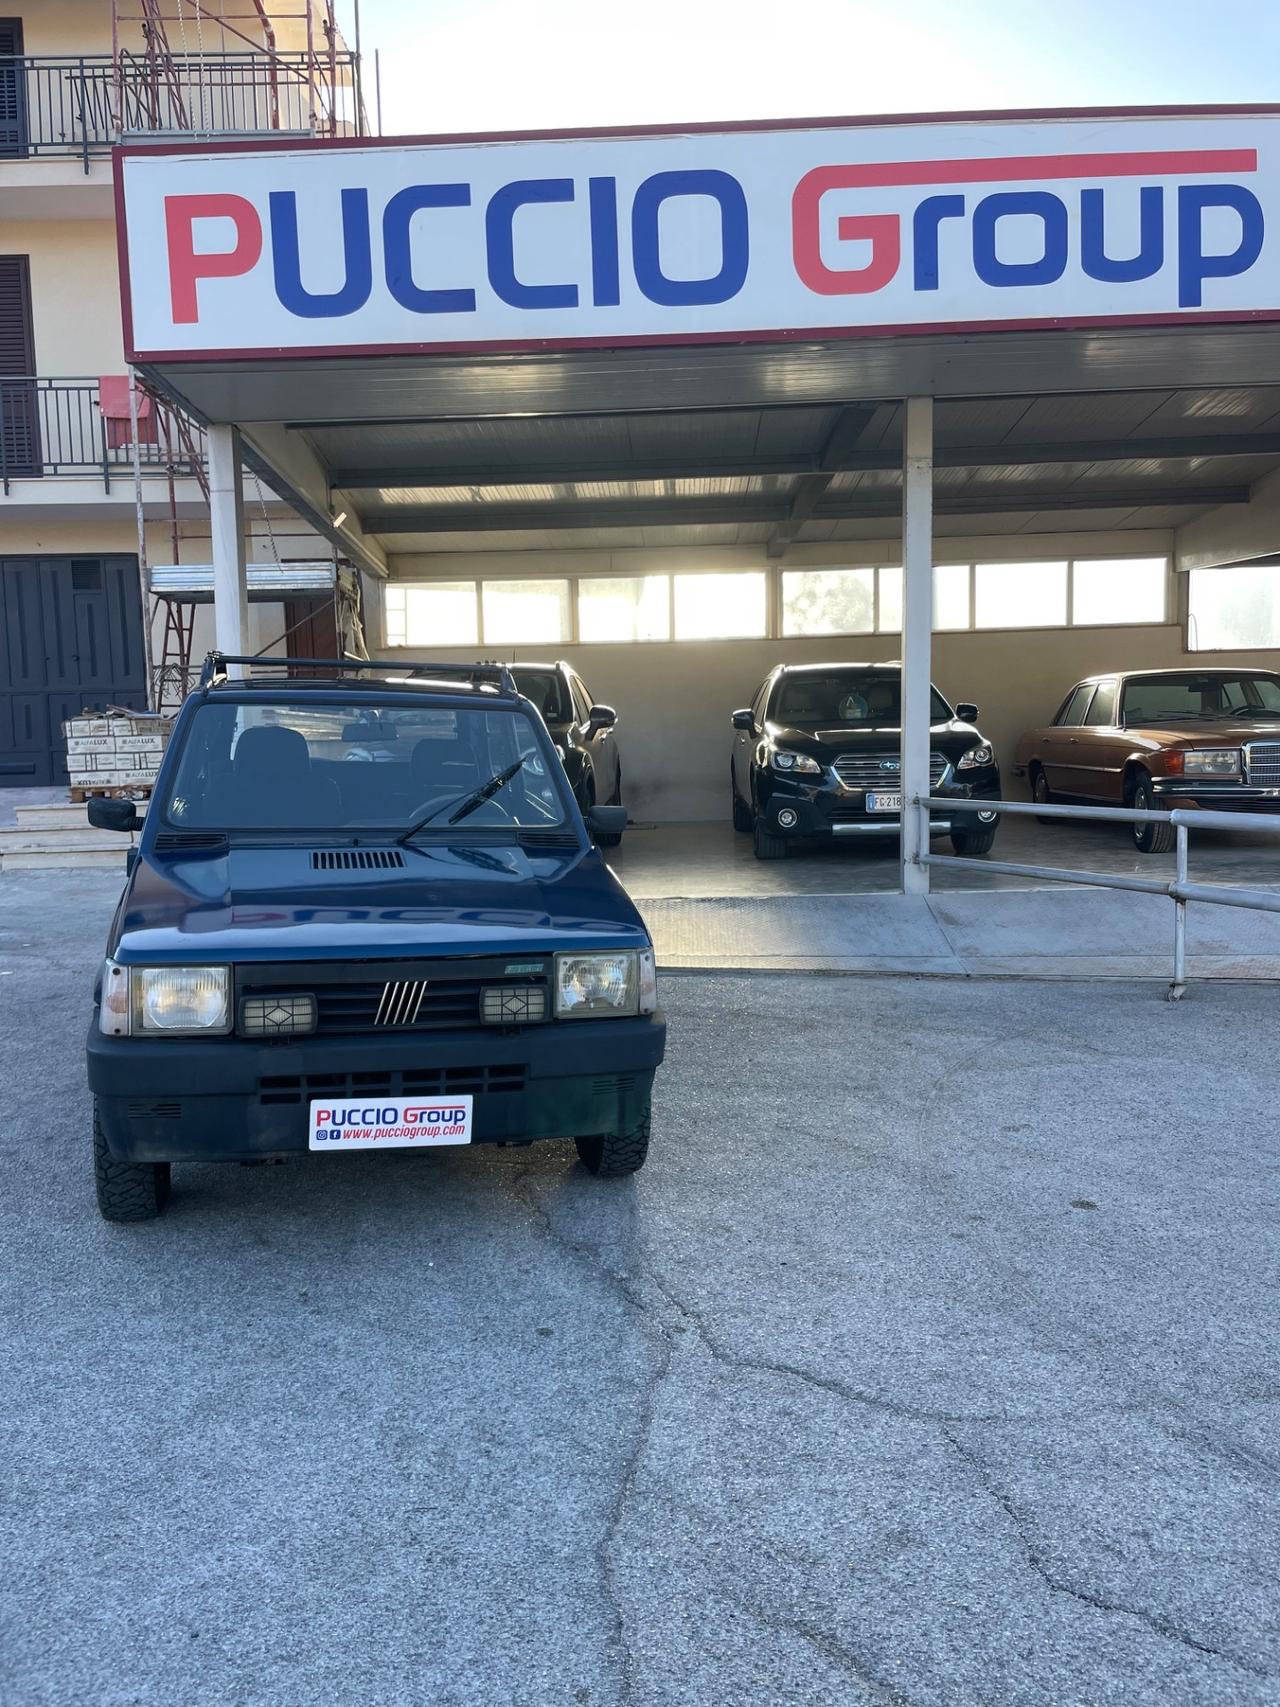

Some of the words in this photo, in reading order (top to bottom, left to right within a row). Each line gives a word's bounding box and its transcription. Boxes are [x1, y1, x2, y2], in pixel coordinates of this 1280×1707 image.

[164, 169, 749, 324] PUCCIO
[792, 148, 1265, 308] Group
[316, 1108, 398, 1127] PUCCIO
[403, 1105, 466, 1125] Group
[343, 1124, 465, 1140] www.pucciogroup.com
